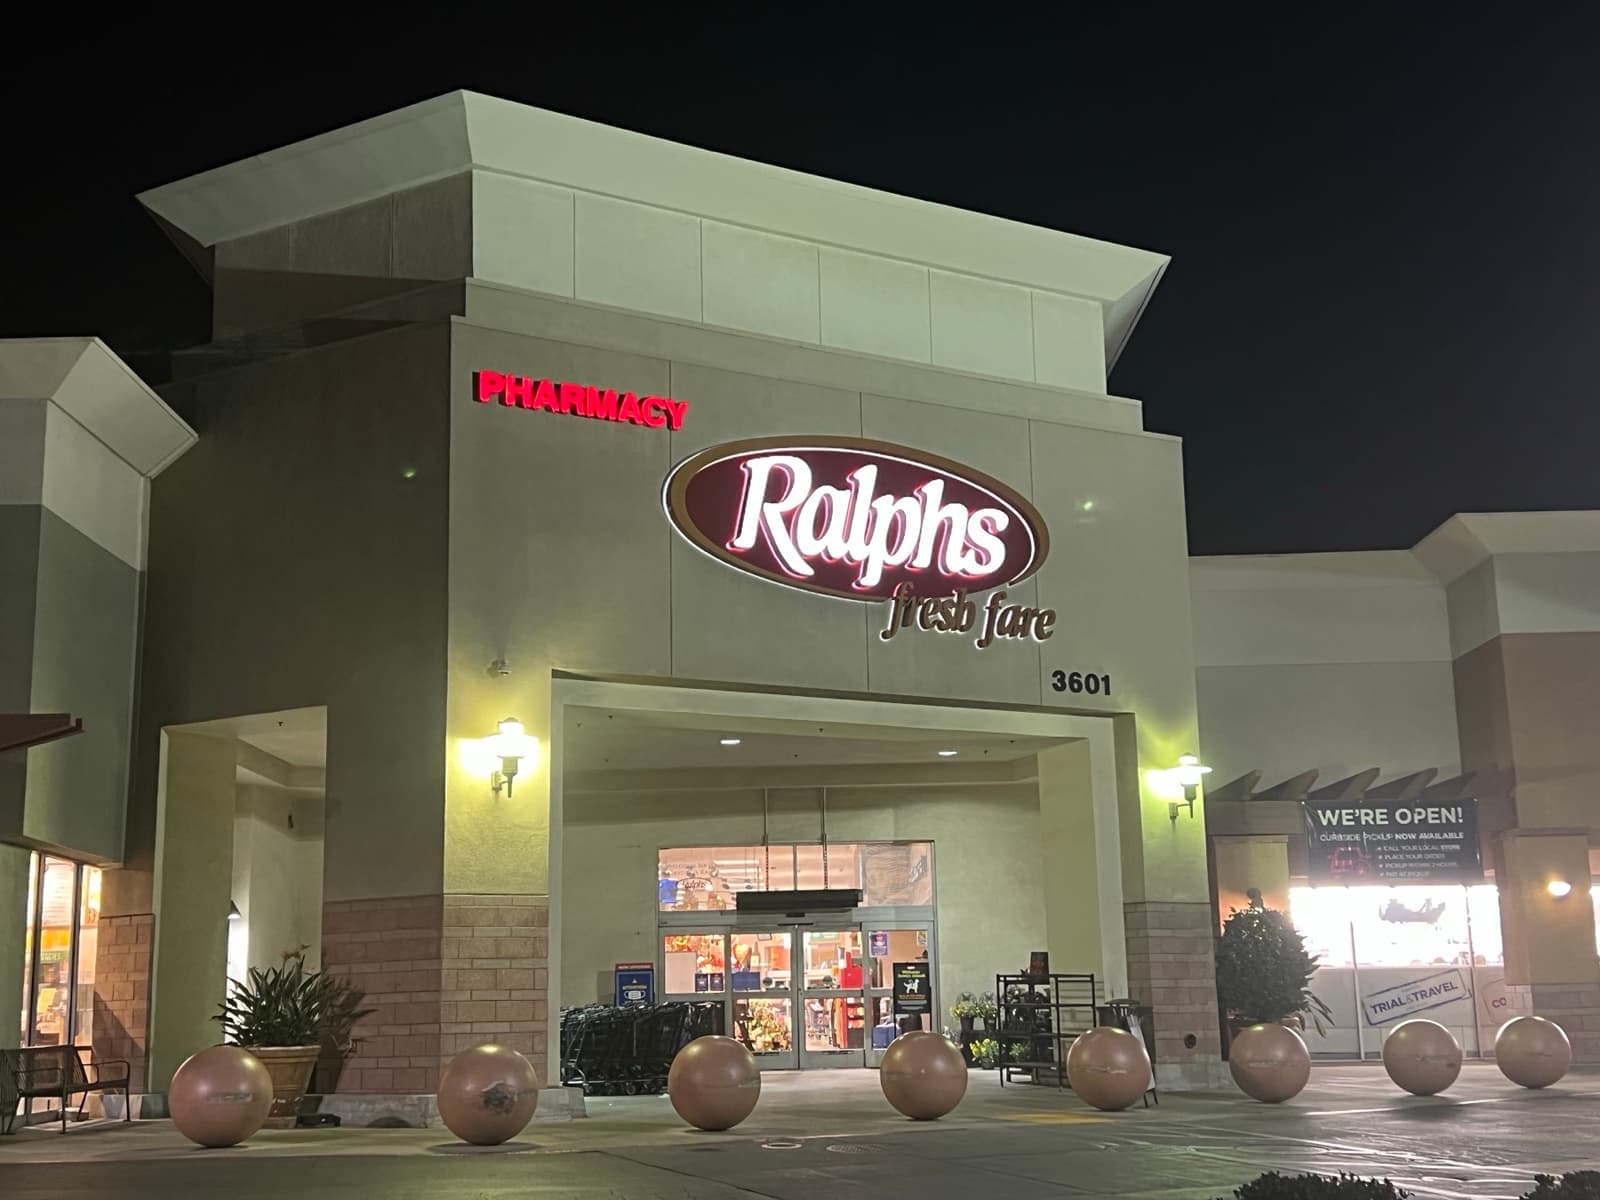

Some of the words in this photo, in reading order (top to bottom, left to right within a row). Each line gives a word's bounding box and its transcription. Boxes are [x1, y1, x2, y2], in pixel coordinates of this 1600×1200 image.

[473, 369, 688, 430] PHARMACY
[727, 455, 1010, 589] Ralphs
[880, 581, 977, 640] fresh
[974, 591, 1056, 649] fare
[1052, 670, 1111, 696] 3601
[1317, 808, 1389, 826] WE'RE
[1395, 807, 1463, 824] OPEN!
